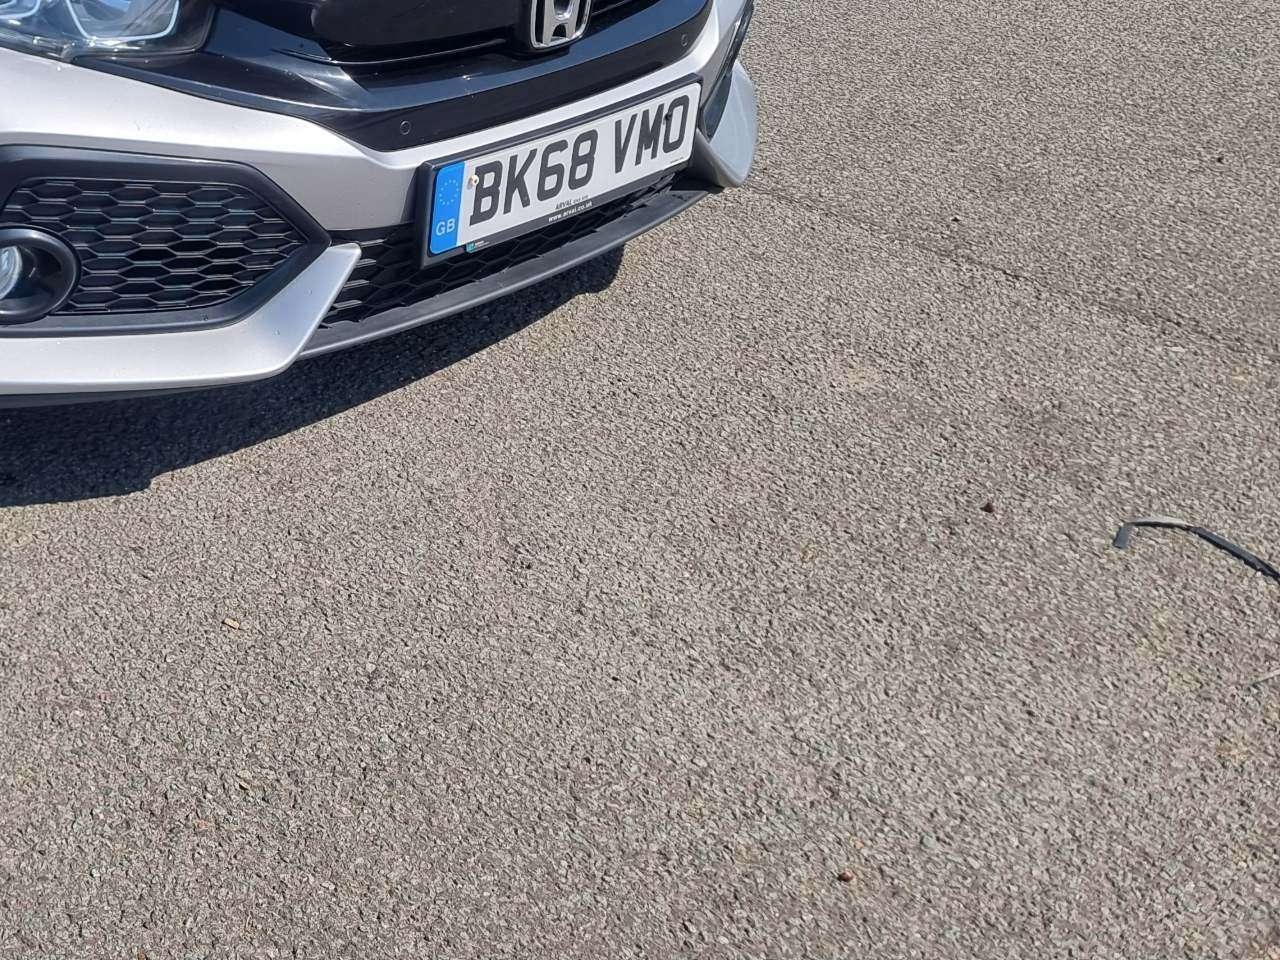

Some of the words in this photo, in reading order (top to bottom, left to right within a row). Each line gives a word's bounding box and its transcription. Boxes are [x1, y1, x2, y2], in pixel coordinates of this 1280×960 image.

[469, 129, 598, 227] BK68
[614, 94, 690, 173] VMO
[435, 218, 455, 236] GB
